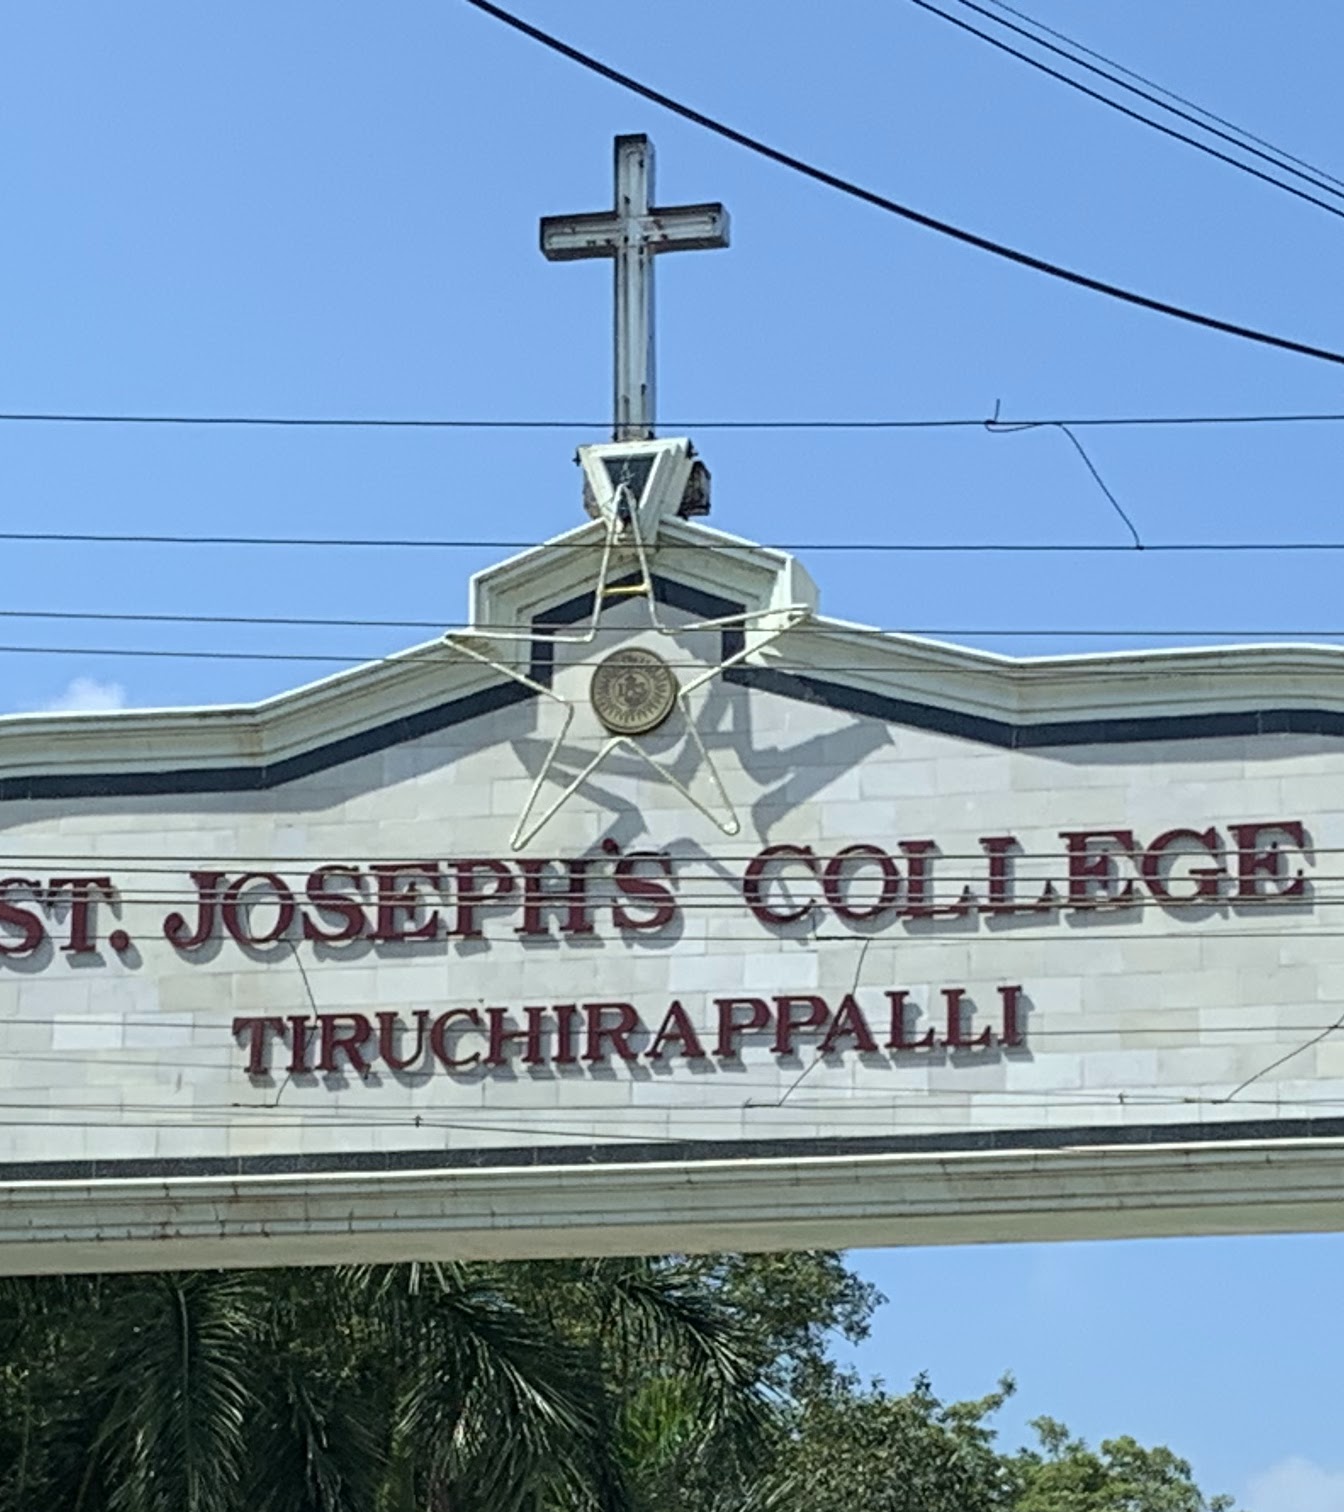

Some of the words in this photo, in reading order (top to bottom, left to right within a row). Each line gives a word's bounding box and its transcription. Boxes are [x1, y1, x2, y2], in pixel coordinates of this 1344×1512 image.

[164, 837, 678, 950] JOSEPH'S
[741, 821, 1318, 928] COLLEGE
[233, 984, 1026, 1078] TIRUCHIRAPPALLI
